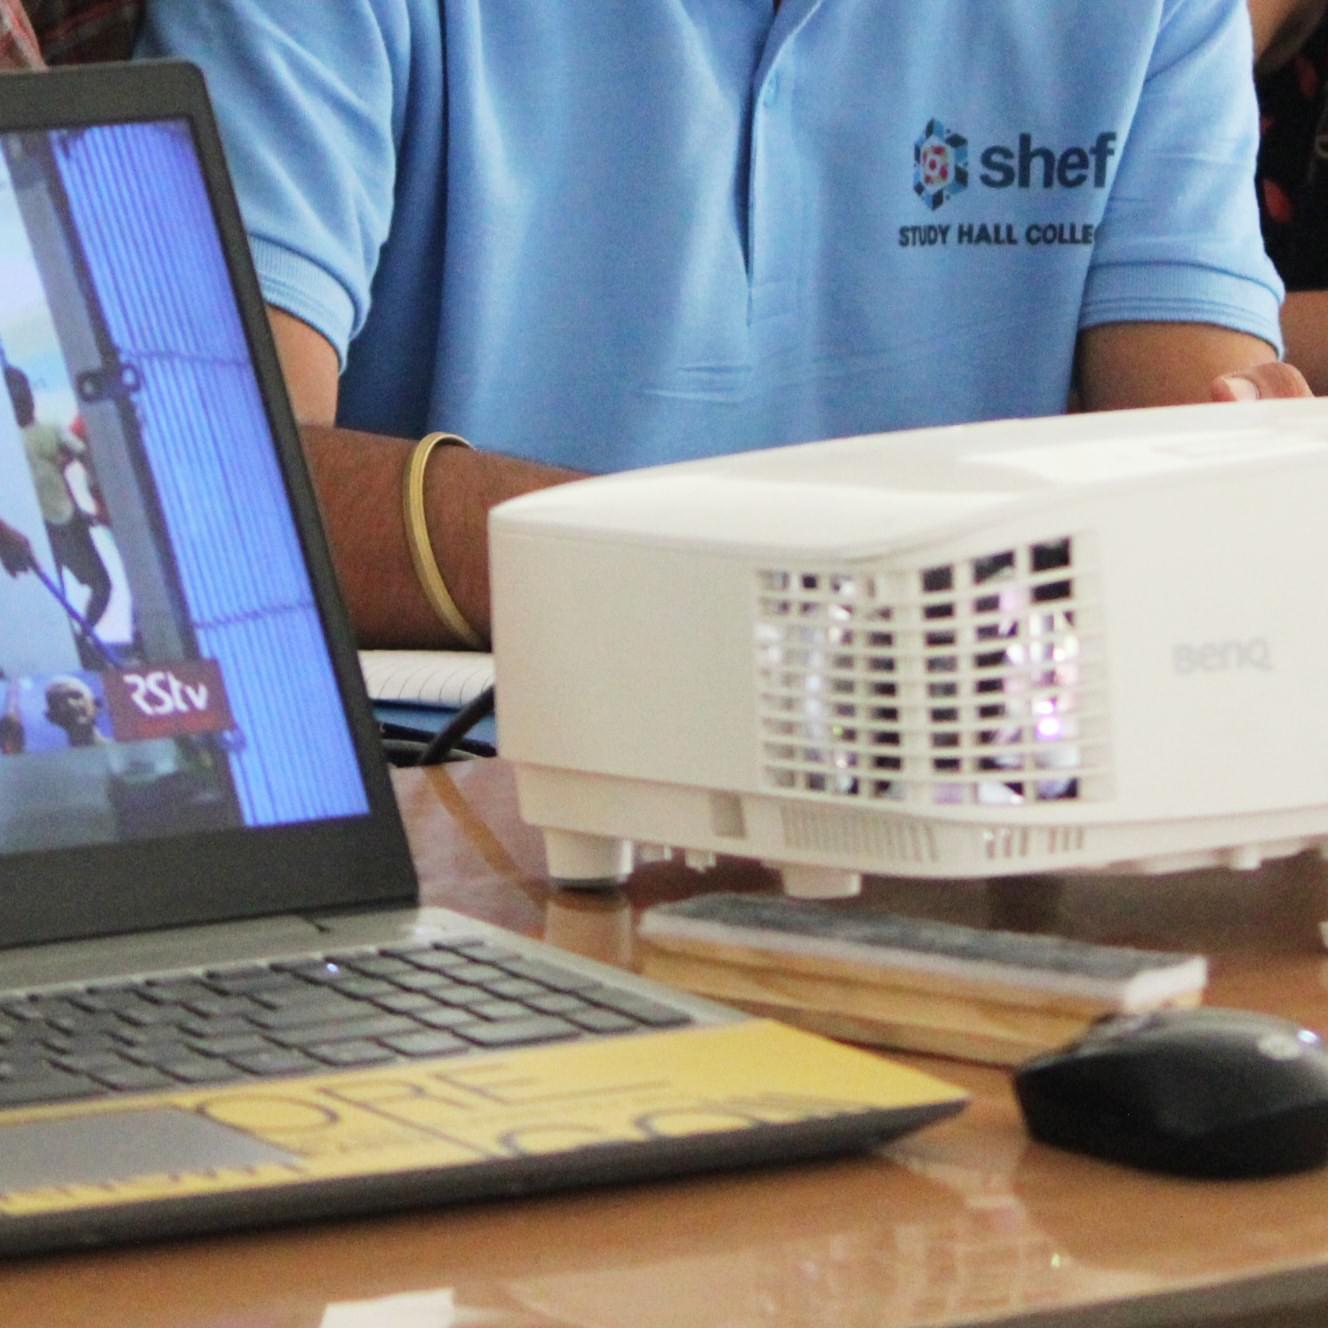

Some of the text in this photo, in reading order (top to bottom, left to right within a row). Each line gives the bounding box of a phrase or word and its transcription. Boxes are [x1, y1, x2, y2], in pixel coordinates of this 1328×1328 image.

[979, 131, 1117, 189] shef
[899, 224, 950, 247] STUDY
[957, 223, 1018, 246] HALL
